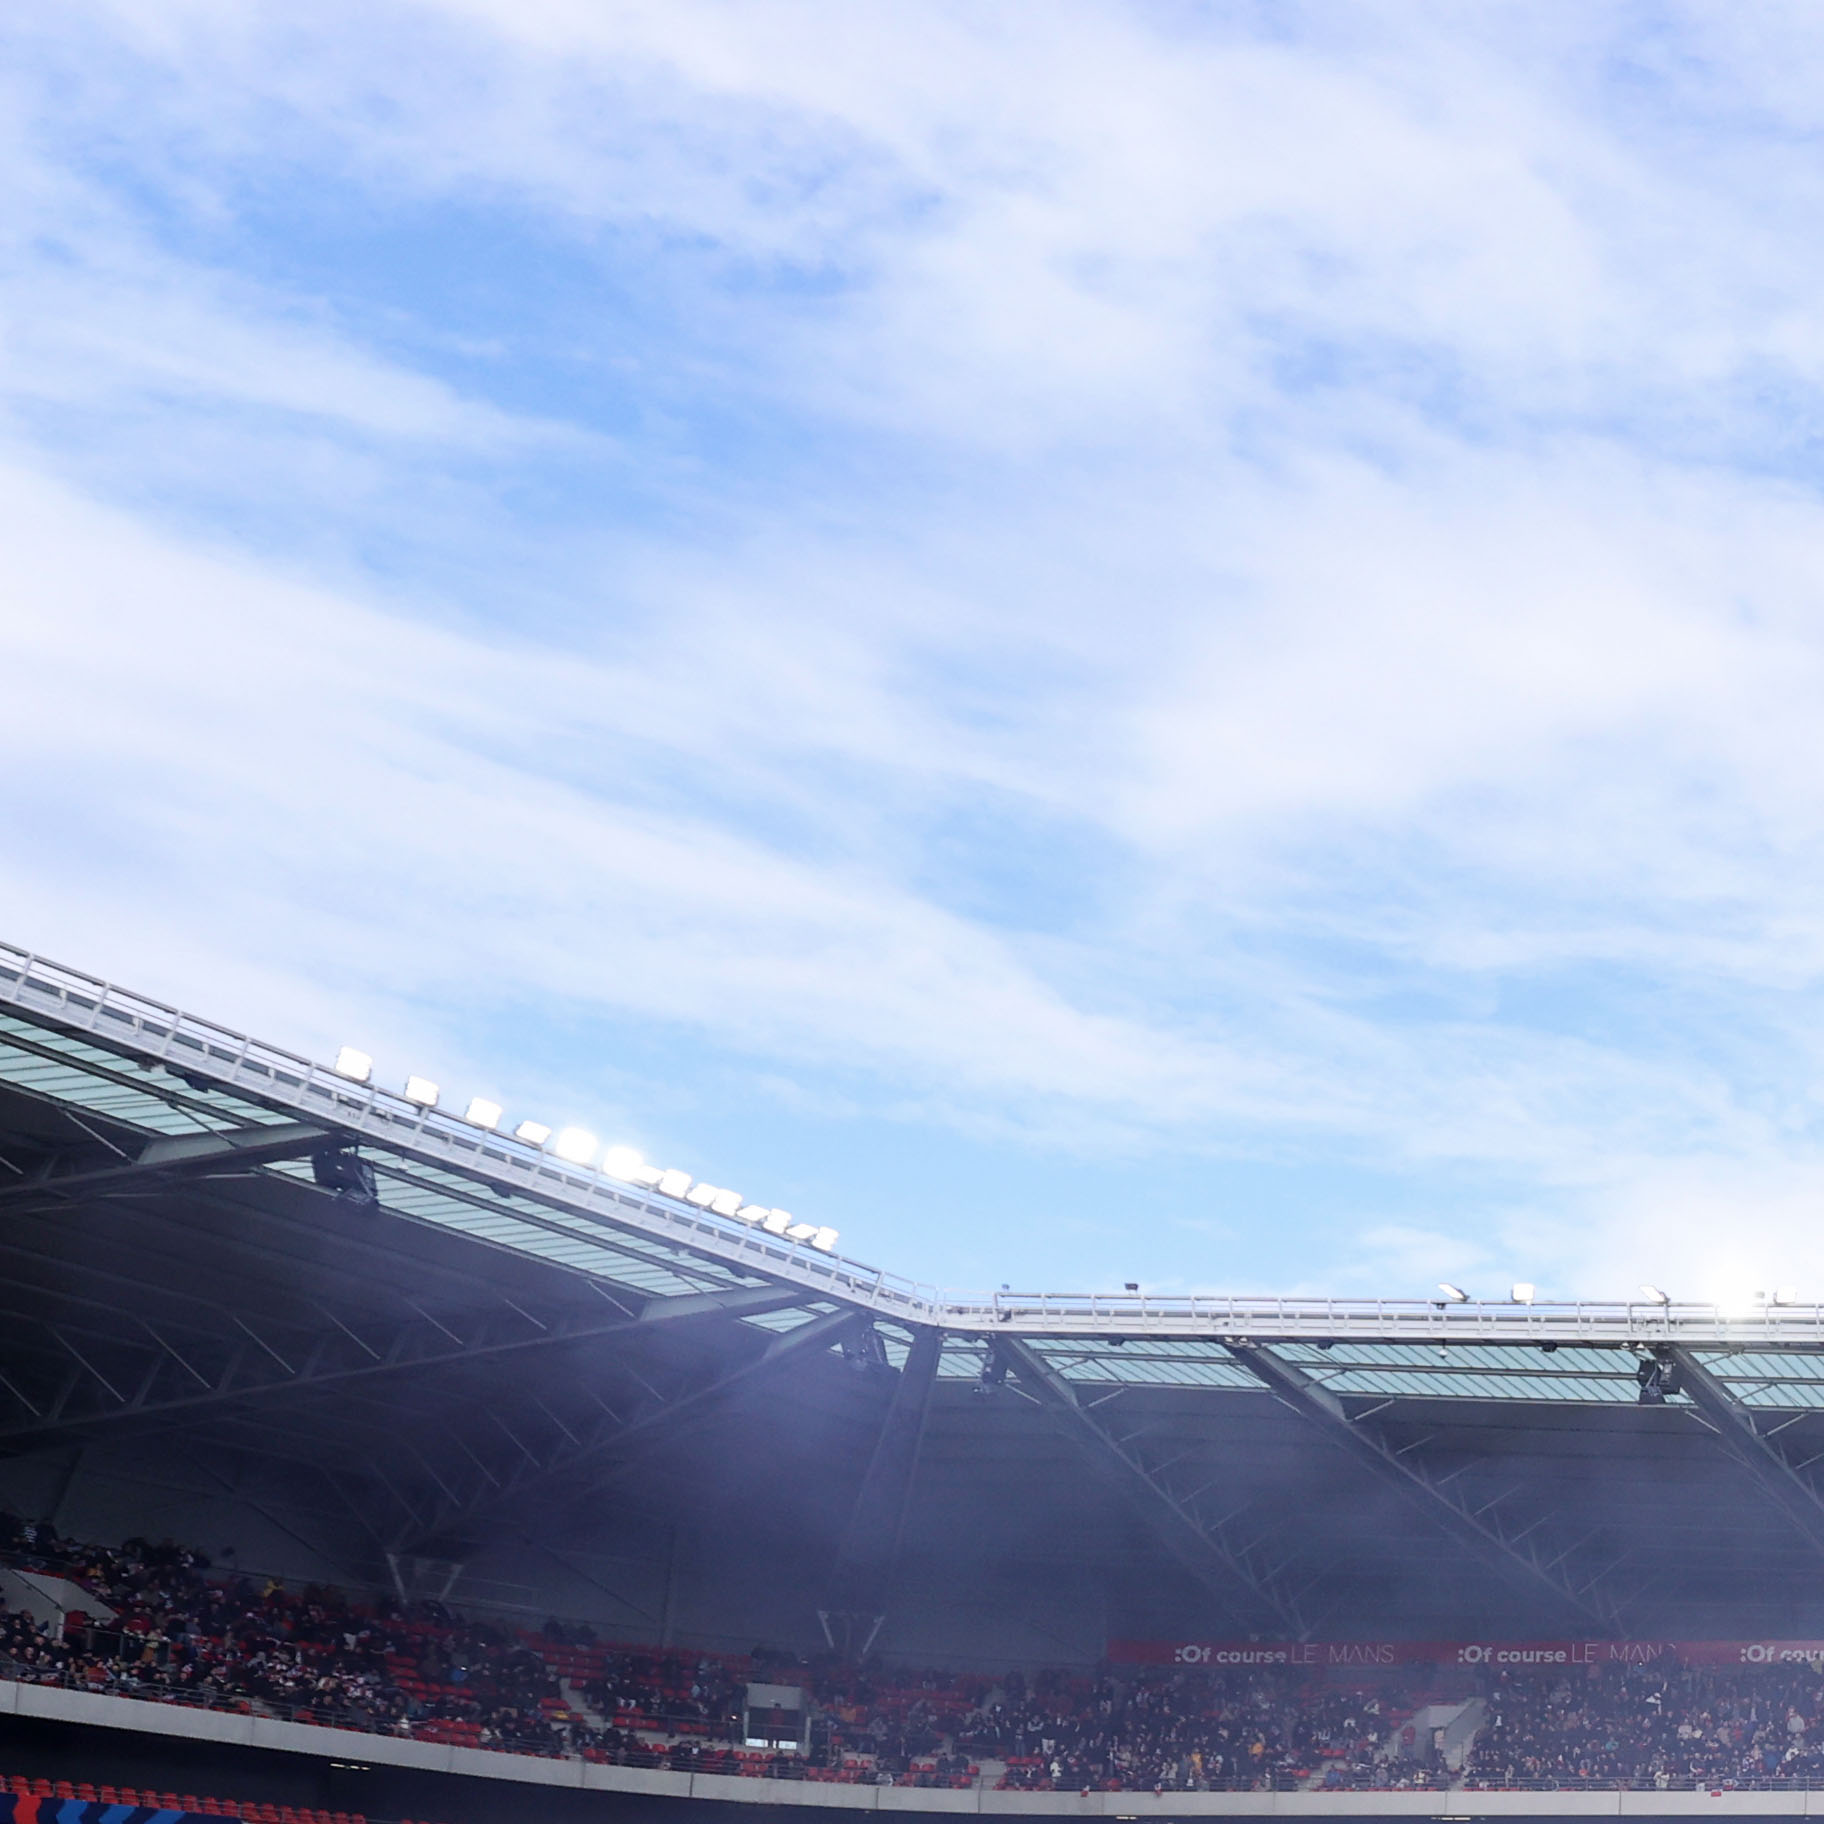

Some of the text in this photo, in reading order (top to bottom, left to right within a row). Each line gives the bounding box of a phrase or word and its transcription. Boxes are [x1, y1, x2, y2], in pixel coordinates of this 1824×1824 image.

[1291, 1644, 1319, 1663] LE
[1497, 1650, 1566, 1663] course
[1572, 1643, 1599, 1663] LE
[1610, 1643, 1676, 1663] MAN
